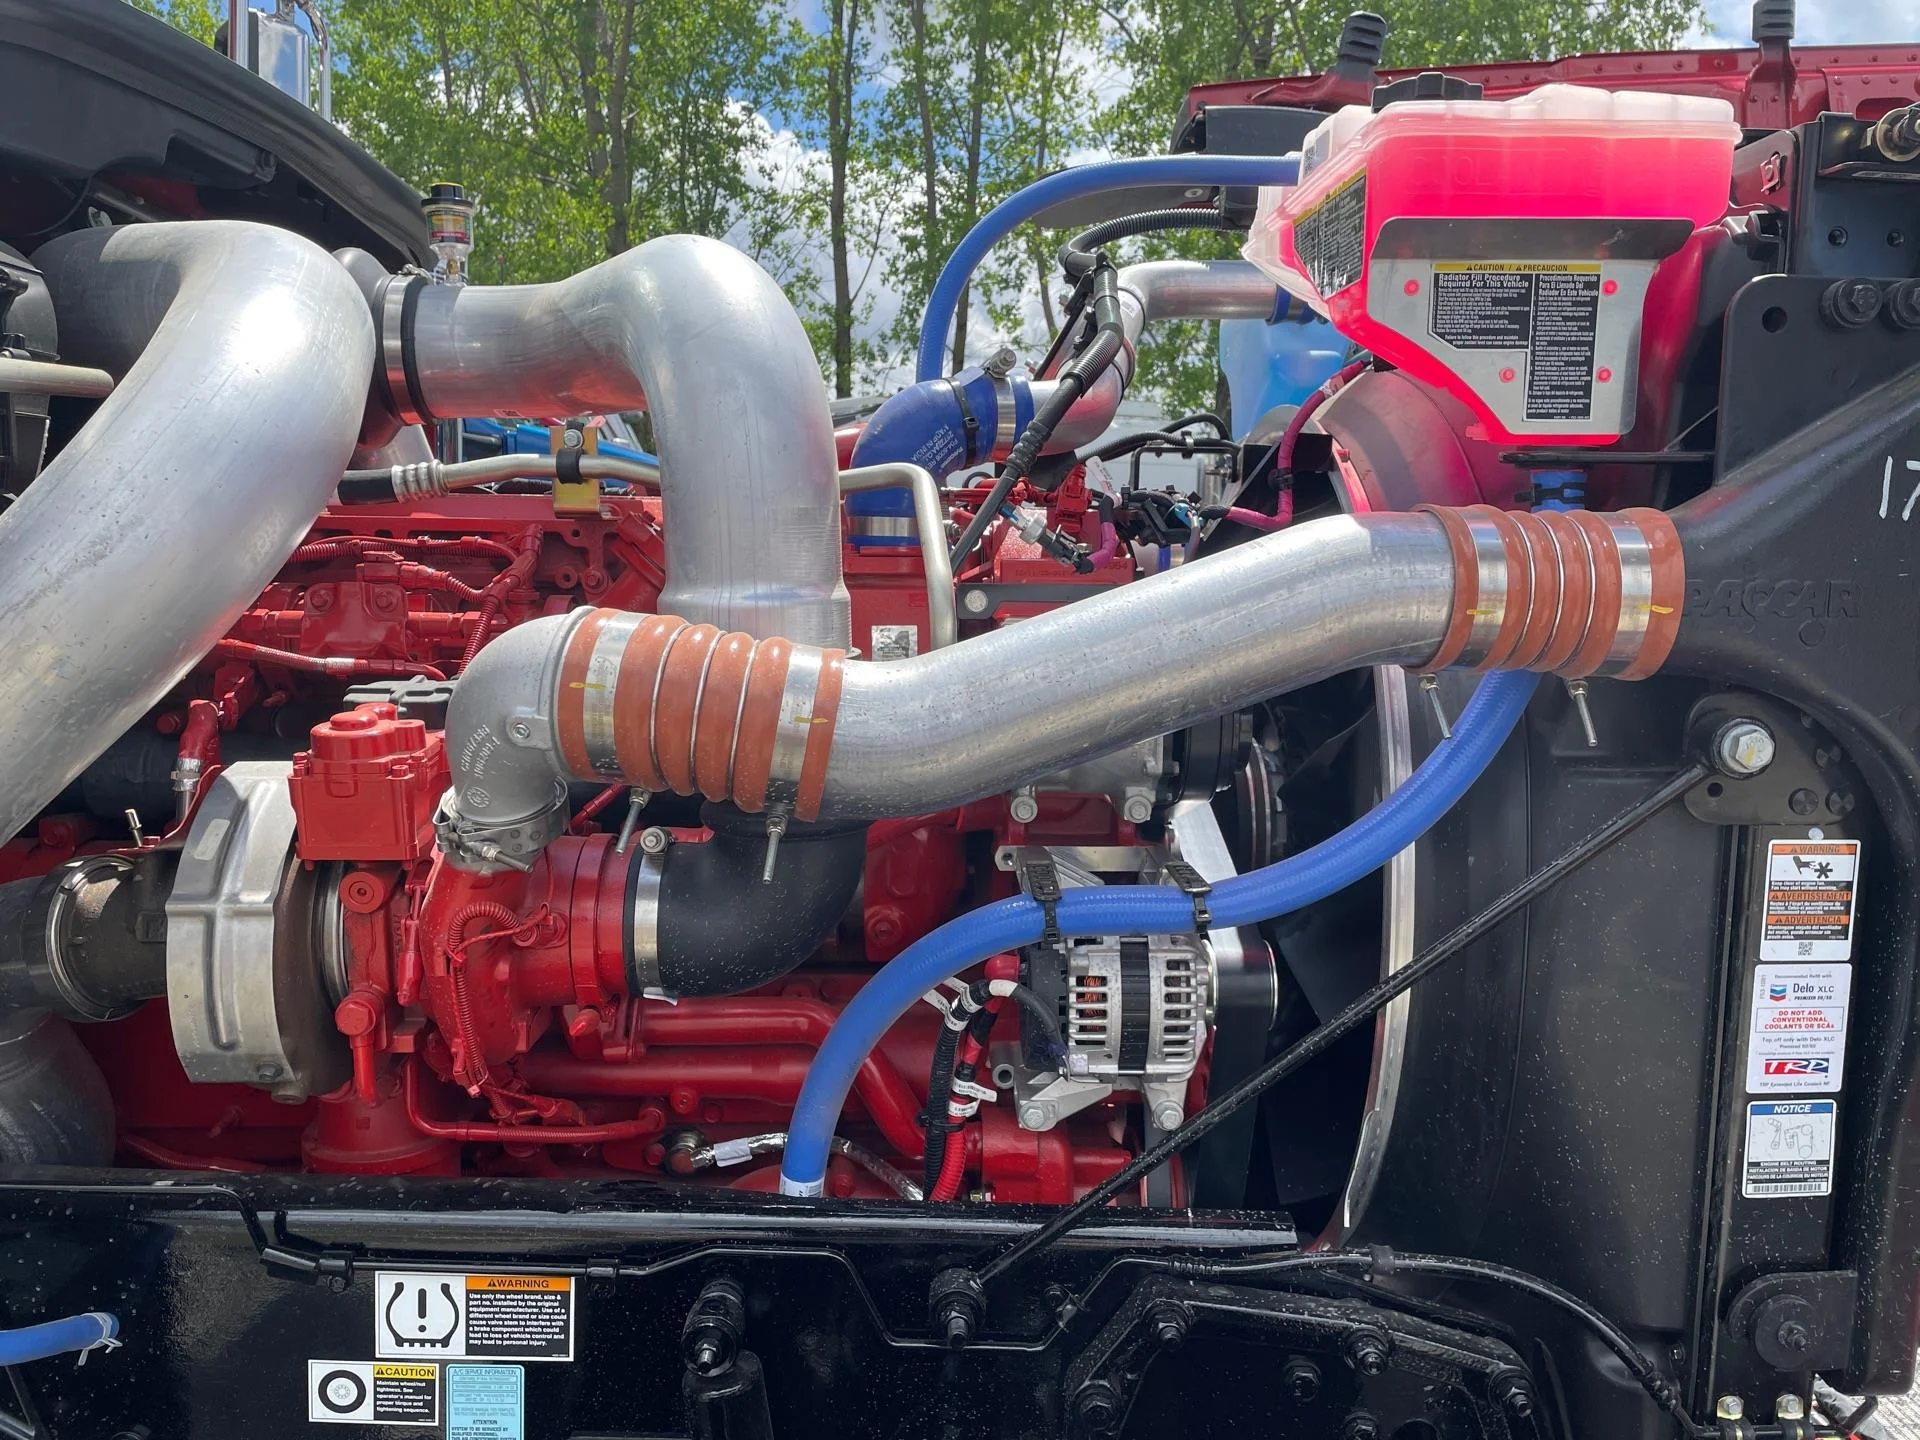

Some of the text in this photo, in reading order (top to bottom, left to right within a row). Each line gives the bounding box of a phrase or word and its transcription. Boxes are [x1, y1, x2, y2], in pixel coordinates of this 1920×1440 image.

[1781, 892, 1849, 900] AVERTISSEMENT
[1784, 916, 1841, 924] ADVERTENCIA
[1793, 983, 1814, 993] Delo
[1769, 1059, 1828, 1073] TRP
[1774, 1105, 1812, 1113] NOTICE
[496, 1280, 549, 1288] WARNING
[385, 1367, 434, 1377] CAUTION
